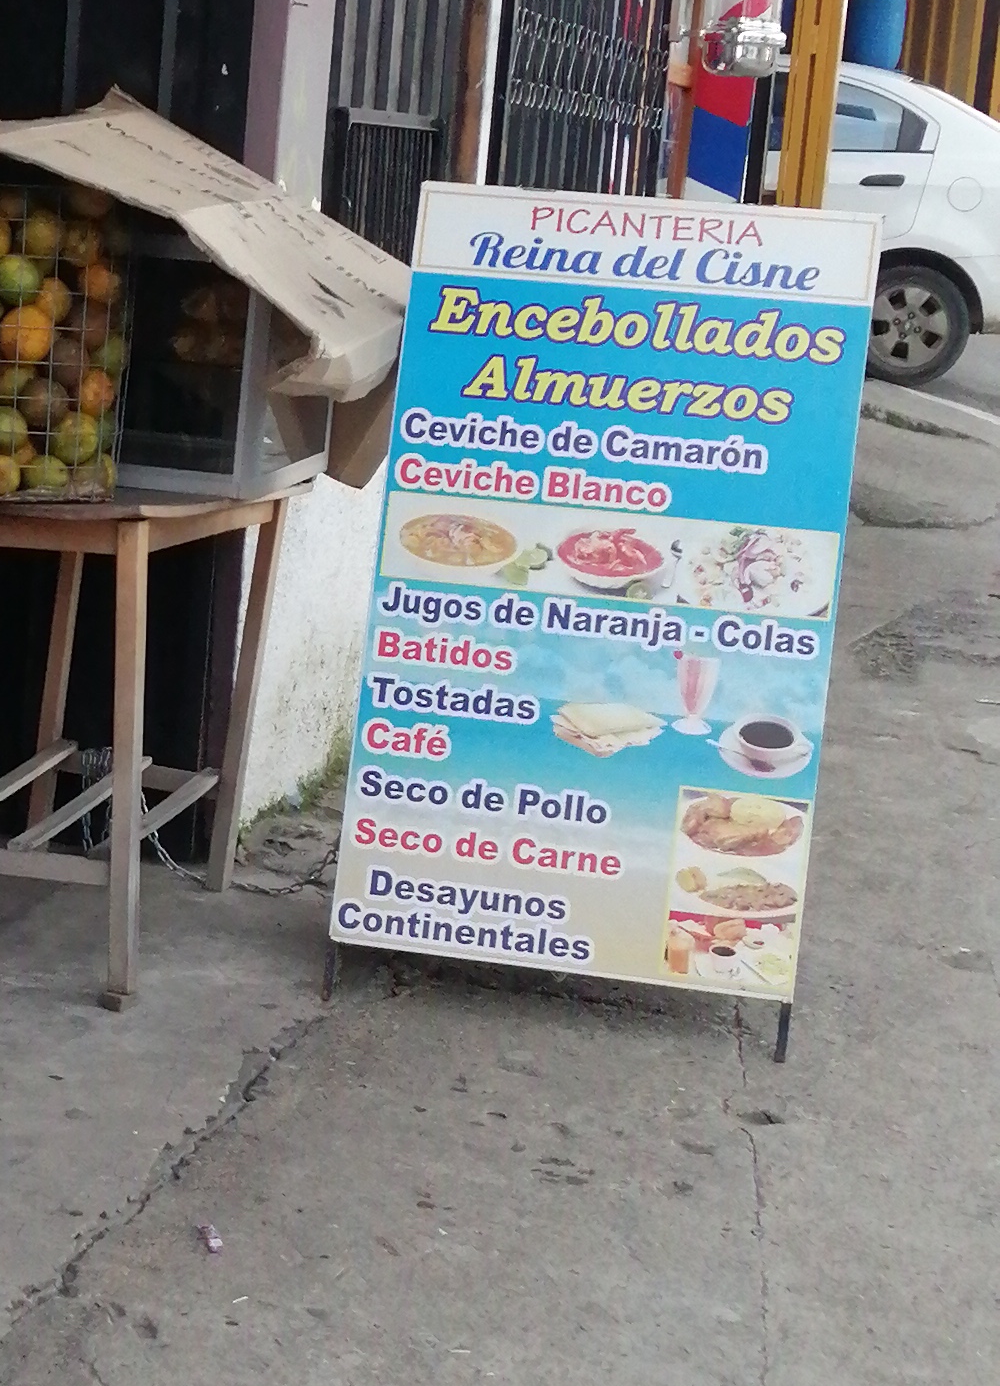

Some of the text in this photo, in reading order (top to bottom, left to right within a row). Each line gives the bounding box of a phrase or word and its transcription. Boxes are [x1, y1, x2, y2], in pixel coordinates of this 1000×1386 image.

[530, 206, 763, 247] PICANTERIA
[470, 231, 820, 291] Reina del Cisne
[429, 285, 848, 365] Encebollados
[462, 354, 795, 425] Almuerzos
[404, 412, 763, 470] Ceviche de Camarón
[399, 461, 668, 509] Ceviche Blanco
[382, 586, 481, 626] Jugos
[494, 596, 534, 625] de
[547, 602, 682, 647] Naranja
[717, 620, 816, 655] Colas
[377, 632, 513, 671] Batidos
[372, 678, 536, 720] Tostadas
[366, 723, 447, 756] Café
[361, 772, 608, 825] Seco de Pollo
[355, 820, 622, 875] Seco de Carne
[369, 870, 566, 920] Desayunos
[337, 904, 591, 961] Continentales
